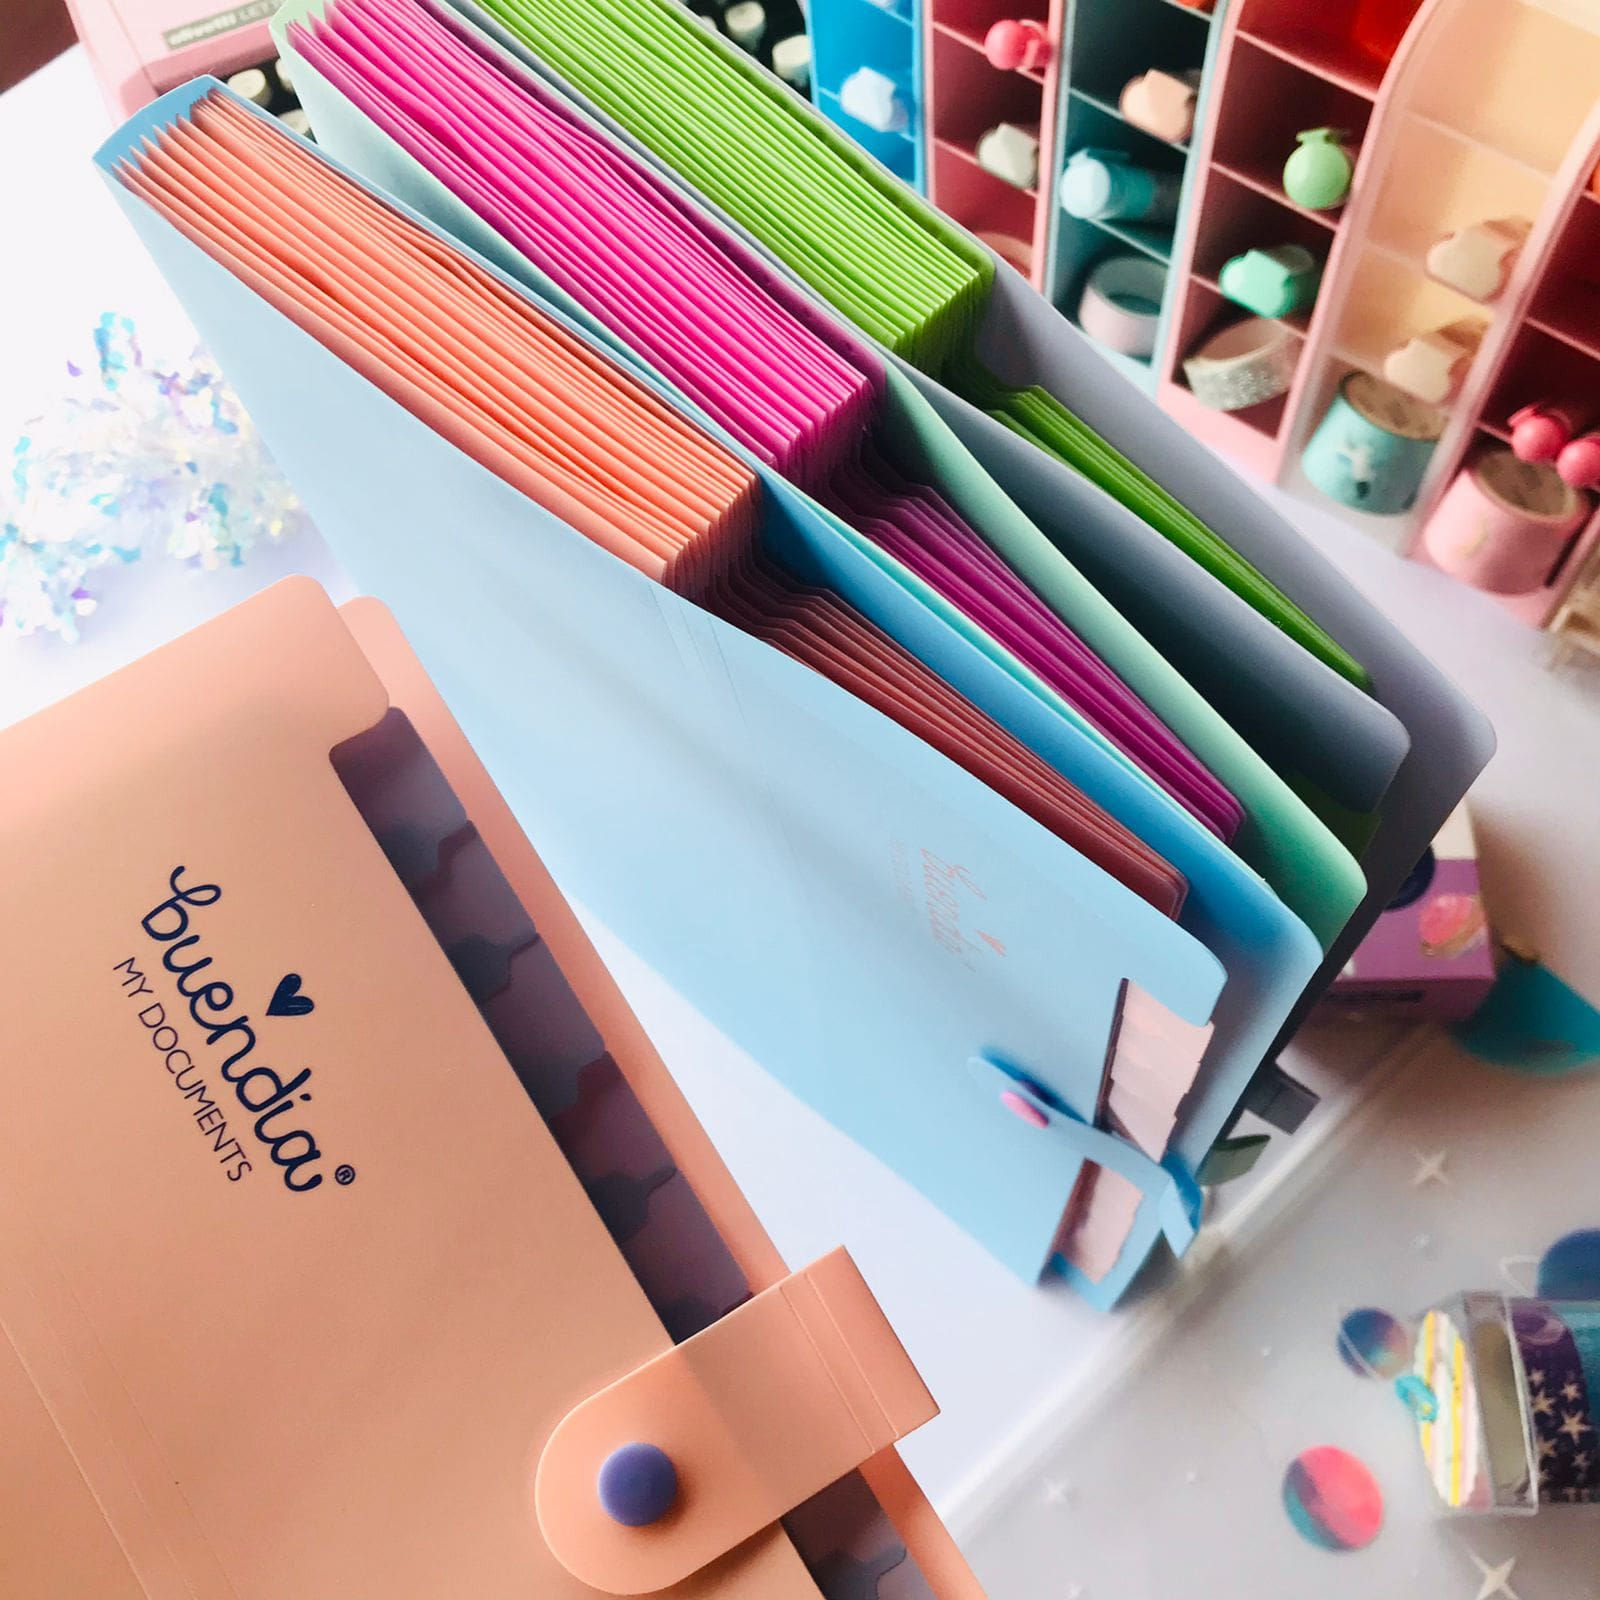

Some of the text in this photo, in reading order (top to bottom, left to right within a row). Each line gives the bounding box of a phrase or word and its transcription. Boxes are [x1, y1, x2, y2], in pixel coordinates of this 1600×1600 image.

[112, 957, 253, 1182] MY DOCUMENTS
[141, 865, 324, 1193] buendia
